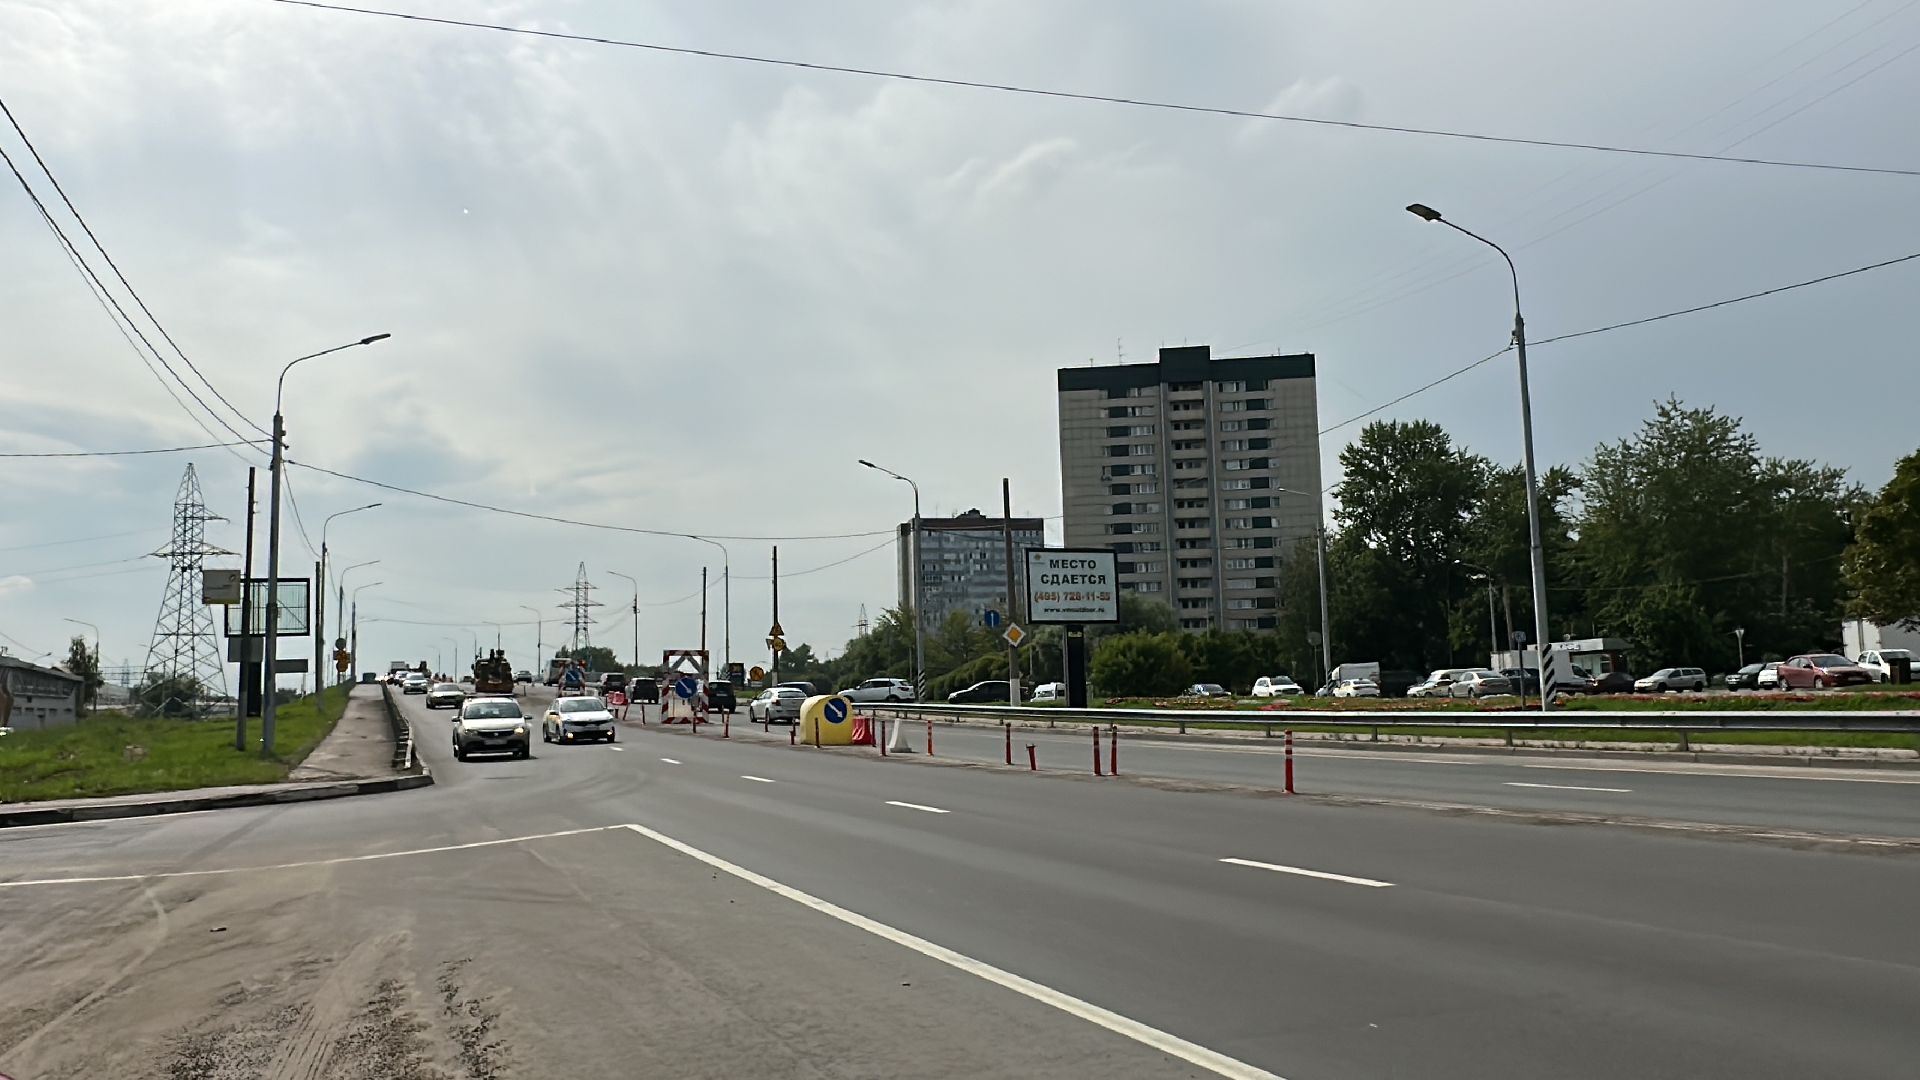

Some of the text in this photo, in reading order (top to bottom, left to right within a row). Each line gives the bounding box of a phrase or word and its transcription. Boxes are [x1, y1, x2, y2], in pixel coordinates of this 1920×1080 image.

[1050, 559, 1097, 569] МЕСТО
[1040, 574, 1106, 585] СДАЕТСЯ
[1034, 592, 1060, 603] (495)
